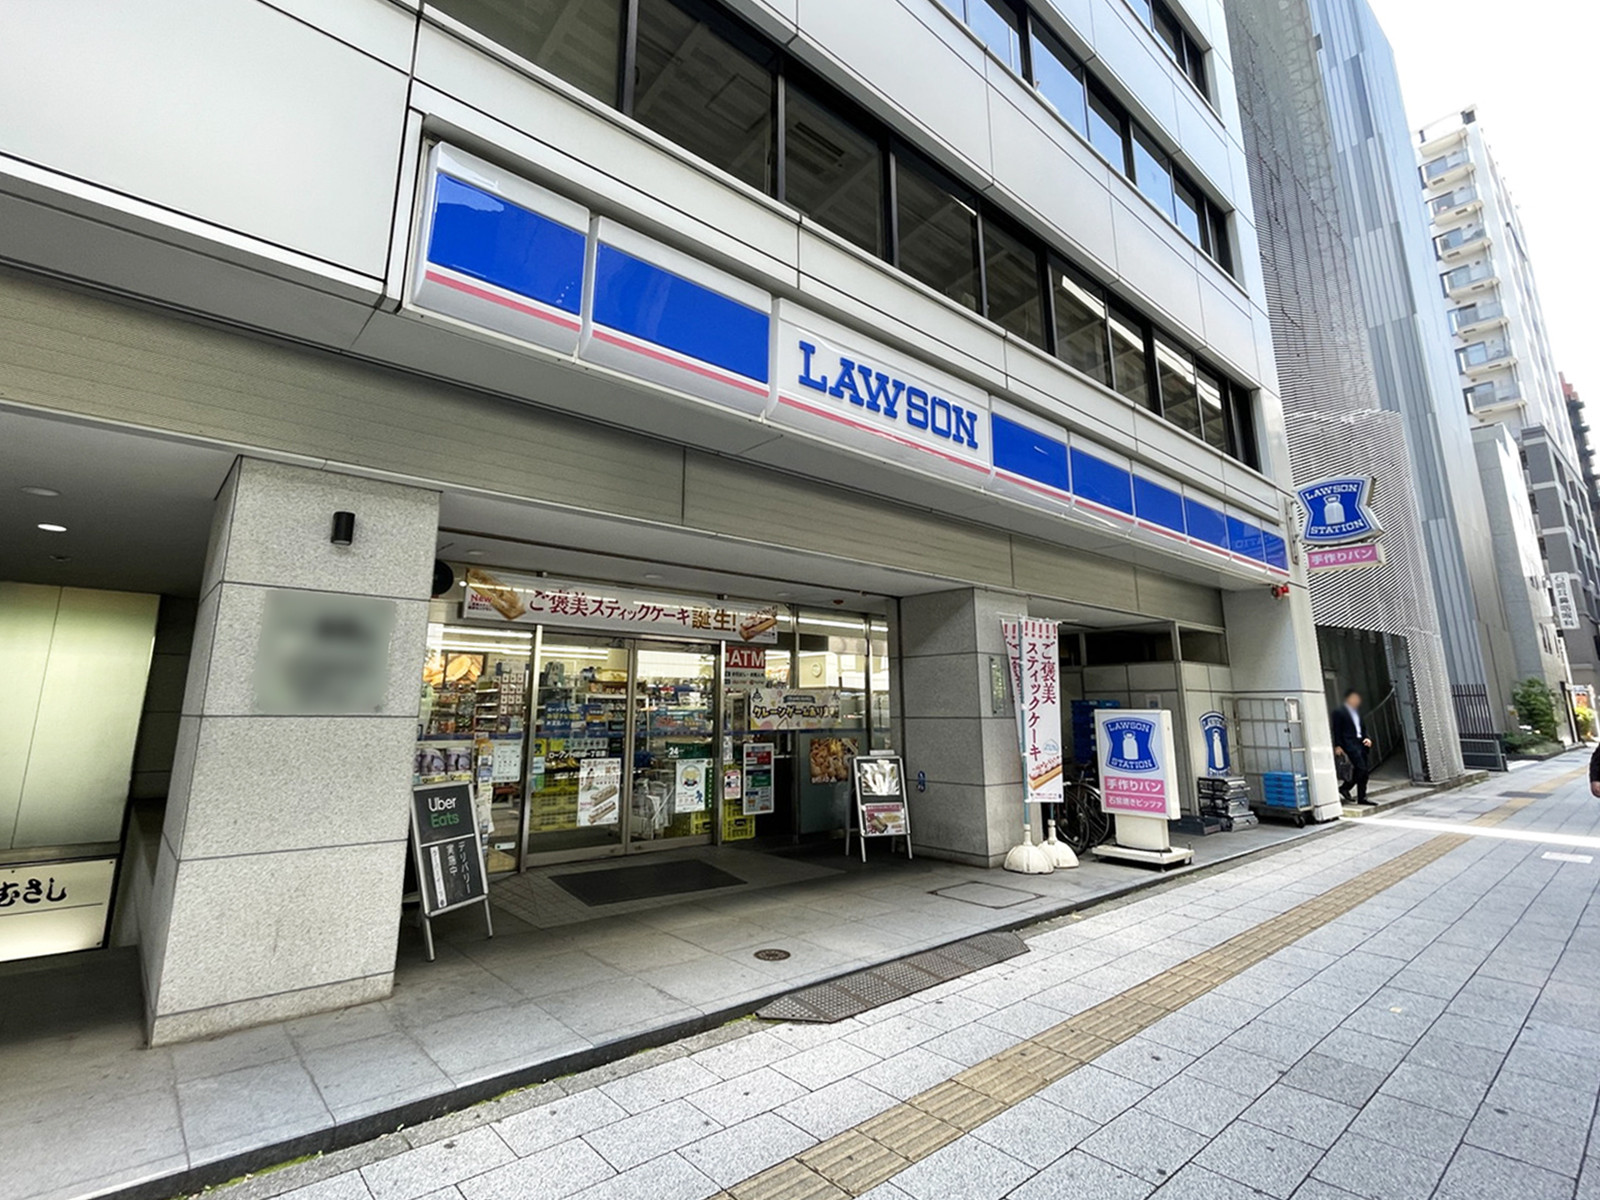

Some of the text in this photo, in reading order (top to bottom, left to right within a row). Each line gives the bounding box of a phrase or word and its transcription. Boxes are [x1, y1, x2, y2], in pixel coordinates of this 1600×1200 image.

[798, 340, 979, 450] LAWSON
[1304, 484, 1358, 500] LAWSON
[1310, 519, 1364, 534] STATION
[1311, 549, 1373, 565] 手作りパン
[730, 649, 765, 668] ATM
[1040, 641, 1056, 705] ご褒美
[1026, 642, 1042, 762] スティックケーキ
[1107, 722, 1150, 732] LAWSON
[1111, 758, 1153, 769] STATION
[1107, 779, 1161, 792] 手作りパン
[428, 797, 456, 812] Uber
[430, 812, 460, 828] Eats
[458, 841, 471, 894] デリバリー
[0, 877, 68, 907] むさし
